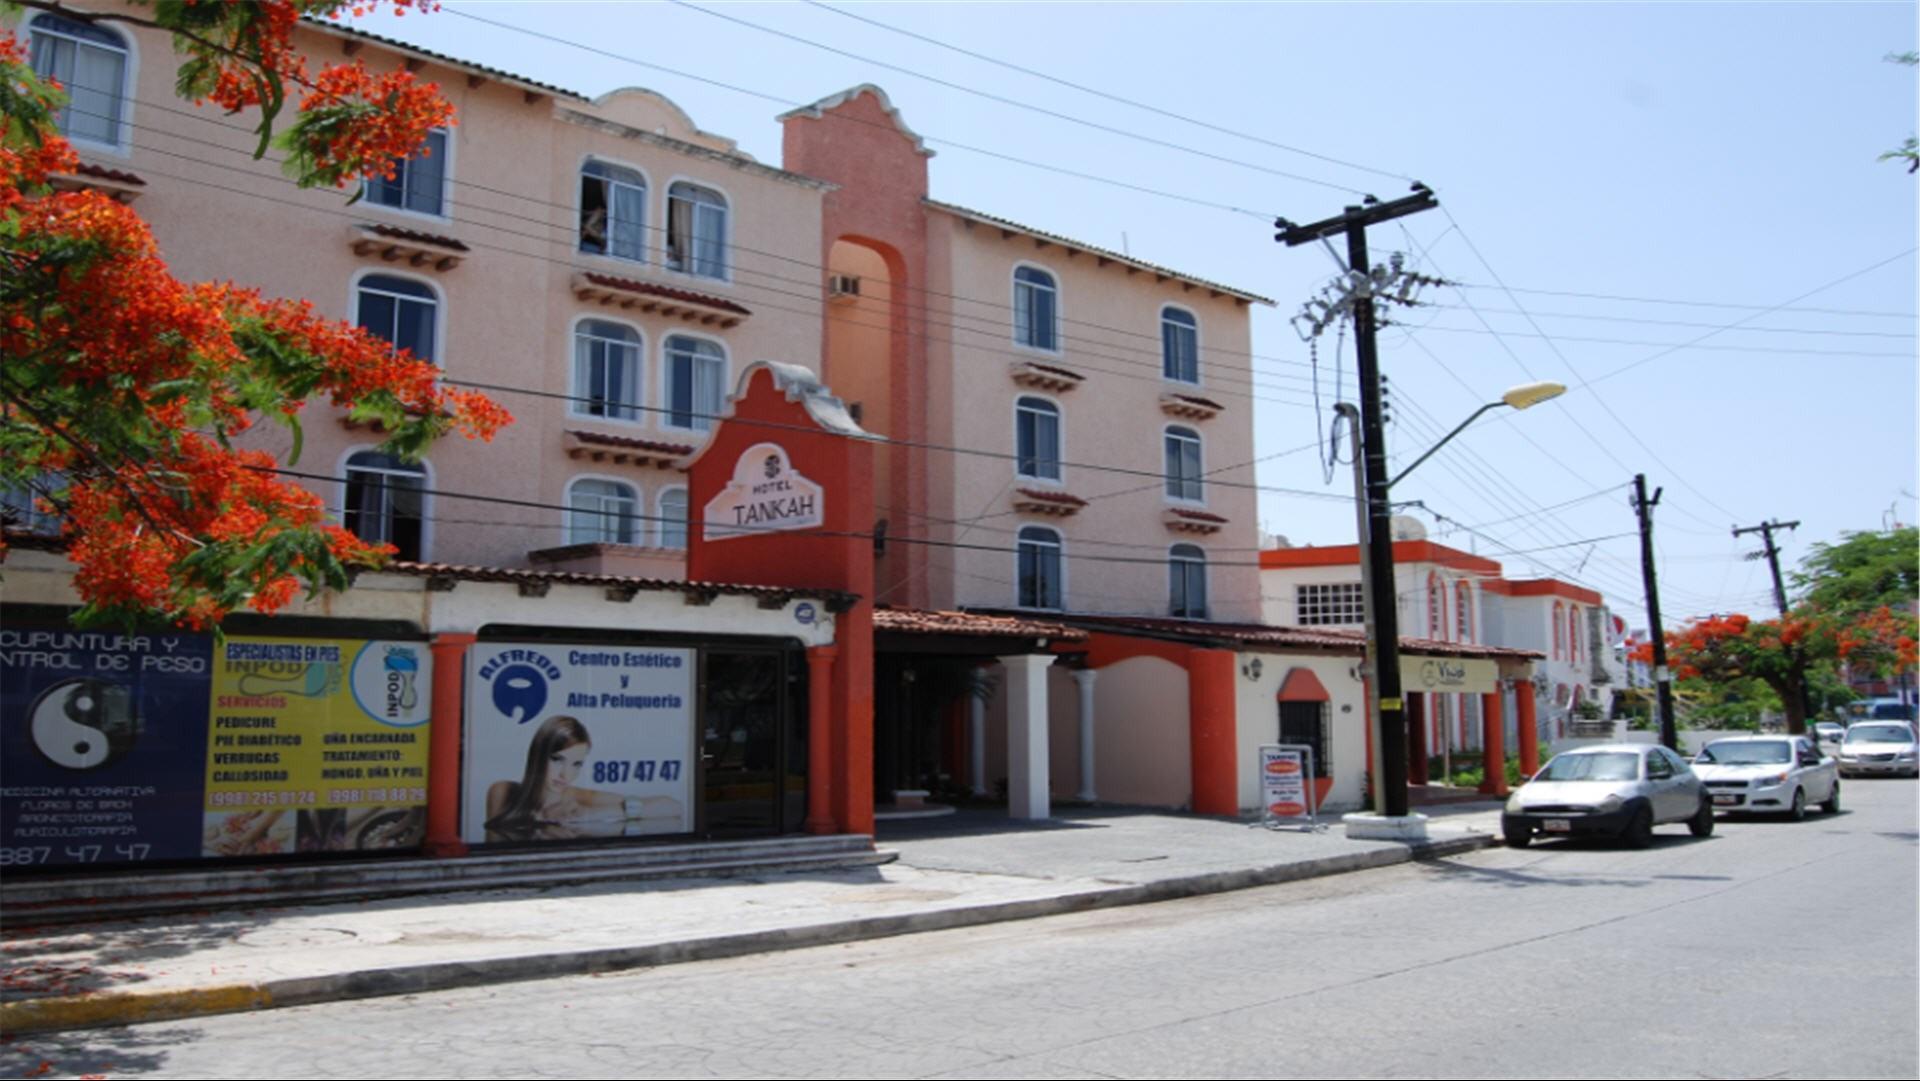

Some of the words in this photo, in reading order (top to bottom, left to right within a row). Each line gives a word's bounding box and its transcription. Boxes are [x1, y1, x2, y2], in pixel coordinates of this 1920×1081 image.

[753, 480, 793, 494] HOTEL
[732, 494, 814, 525] TANKAH
[162, 637, 179, 652] Y
[96, 653, 129, 670] DE
[142, 655, 206, 673] PESO
[478, 649, 561, 681] ALFREDO
[569, 651, 620, 667] Centro
[623, 651, 682, 668] Estético
[225, 661, 302, 674] INPOD
[620, 675, 629, 689] y
[387, 672, 400, 717] INPOD
[567, 693, 597, 708] Alta
[217, 696, 287, 708] SERVICIOS
[216, 716, 276, 728] PEDICURE
[215, 735, 234, 746] PIE
[214, 752, 280, 764] VERRUGAS
[213, 770, 288, 782] CALLOSIDAD
[392, 767, 401, 778] Y
[593, 761, 630, 783] 887
[634, 761, 656, 781] 47
[660, 760, 681, 781] 47
[65, 844, 102, 862] 47
[115, 843, 151, 860] 47
